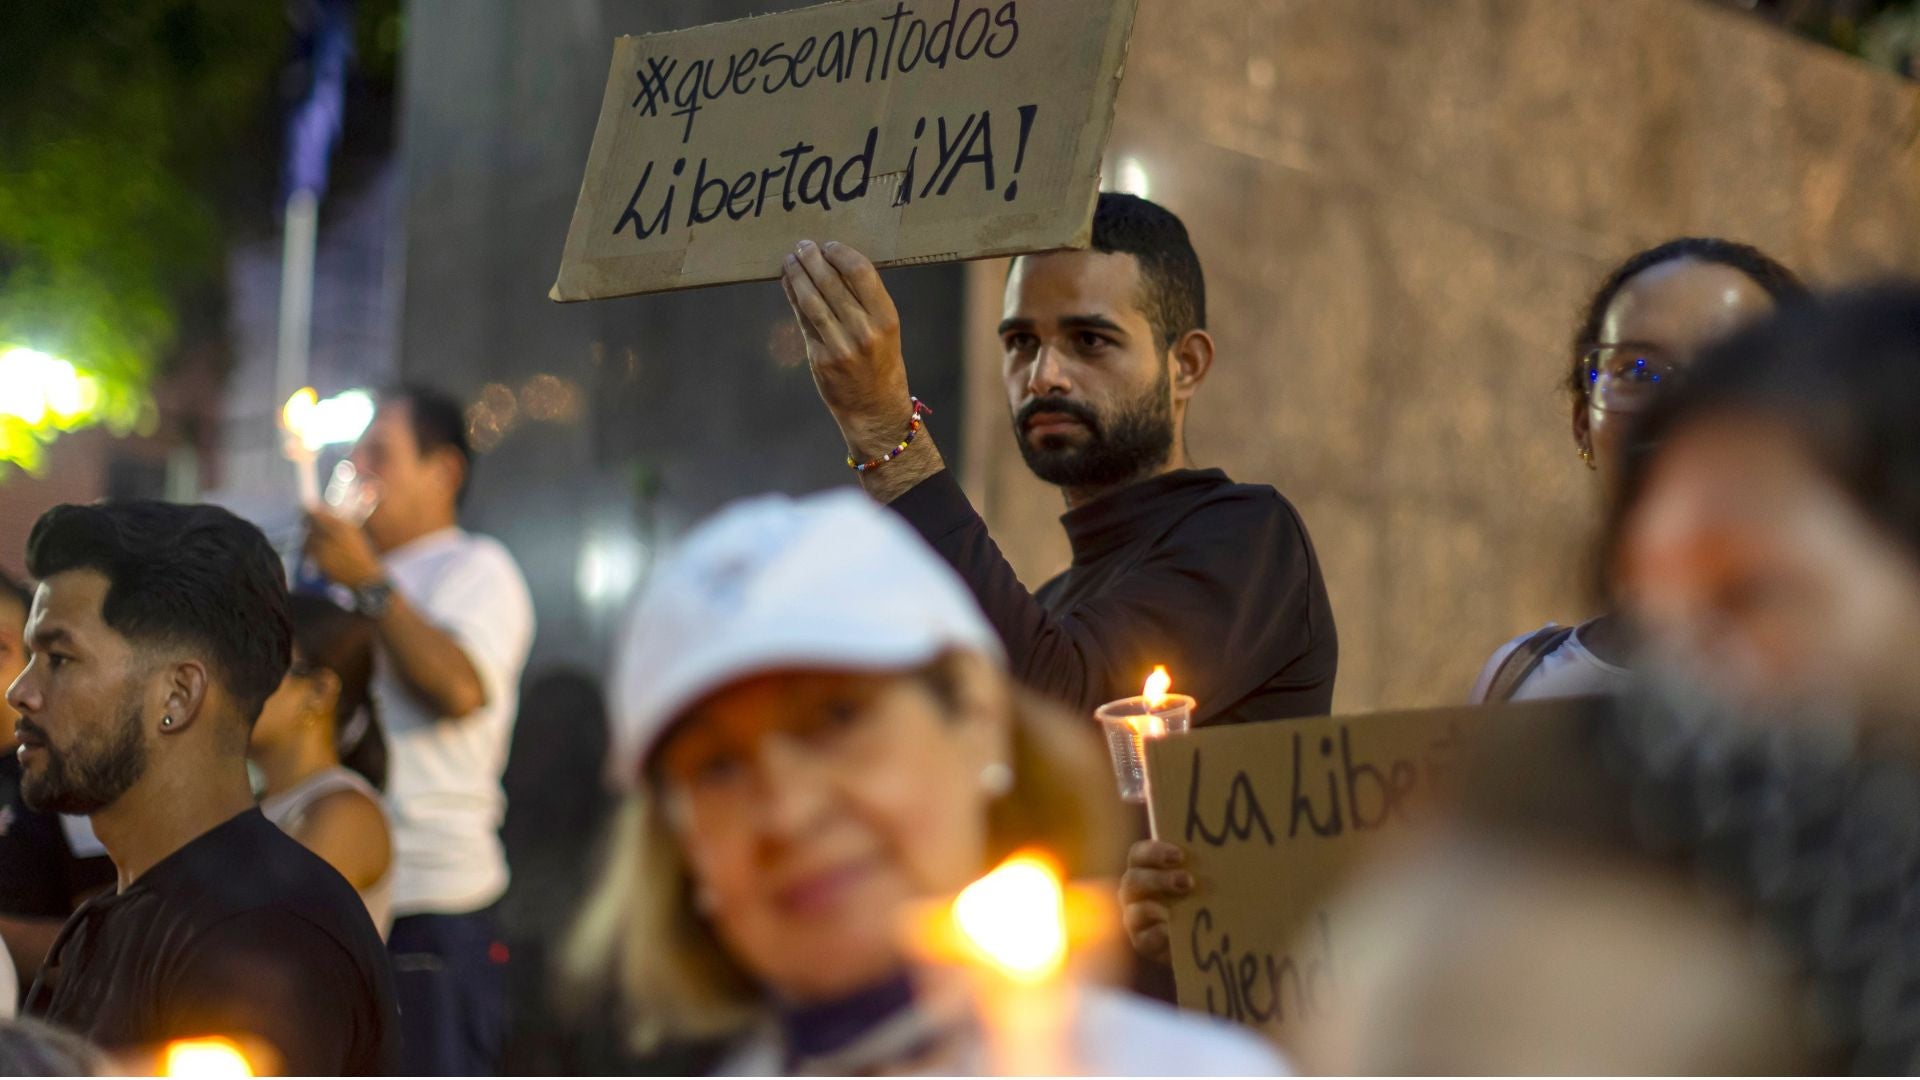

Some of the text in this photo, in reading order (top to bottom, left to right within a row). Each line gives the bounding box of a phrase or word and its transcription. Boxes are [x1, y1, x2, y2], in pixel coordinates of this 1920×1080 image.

[632, 0, 1020, 143] #queseantodos
[612, 126, 880, 240] Libertad
[1185, 746, 1274, 846] La
